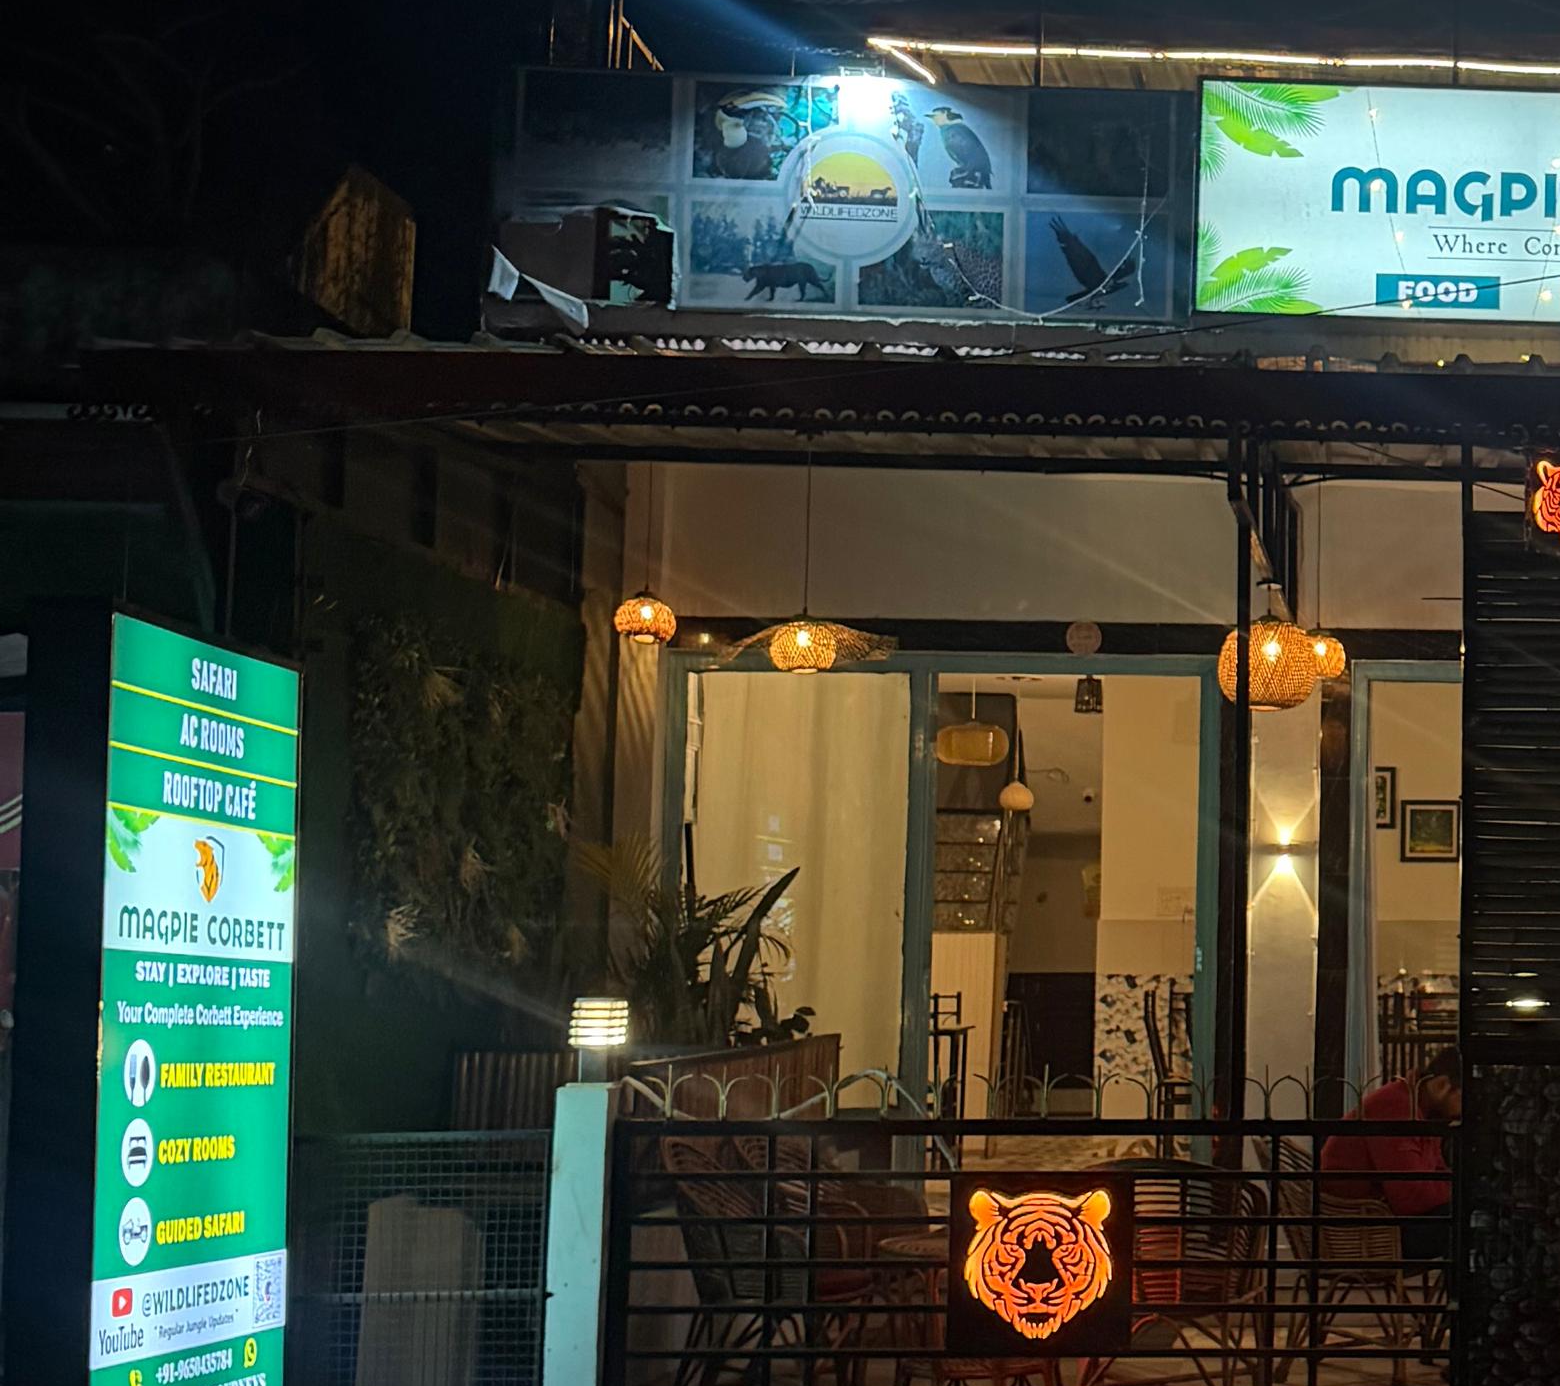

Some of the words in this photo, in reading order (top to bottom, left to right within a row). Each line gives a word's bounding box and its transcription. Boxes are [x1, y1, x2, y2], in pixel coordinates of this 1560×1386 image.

[1432, 233, 1508, 255] Where
[1397, 280, 1479, 304] FOOD
[191, 657, 238, 701] SAFARI
[180, 713, 199, 749] AC
[200, 718, 245, 759] ROOMS
[162, 770, 223, 813] ROOFTOP
[224, 780, 257, 820] CAFÉ
[119, 905, 199, 945] MAGPIE
[207, 915, 285, 951] CORBETT
[135, 960, 166, 983] STAY
[176, 963, 229, 986] EXPLORE
[239, 968, 270, 988] TASTE
[117, 1000, 142, 1023] Your
[144, 1001, 194, 1028] Complete
[195, 1003, 232, 1025] Corbett
[233, 1005, 284, 1030] Experience
[160, 1062, 204, 1088] FAMILY
[205, 1062, 275, 1088] RESTAURANT
[158, 1138, 192, 1165] COZY
[192, 1134, 235, 1162] ROOMS
[156, 1216, 202, 1245] GUIDED
[203, 1210, 245, 1238] SAFARI
[141, 1275, 250, 1317] @WILDLIFEDZONE
[99, 1322, 144, 1356] YouTube
